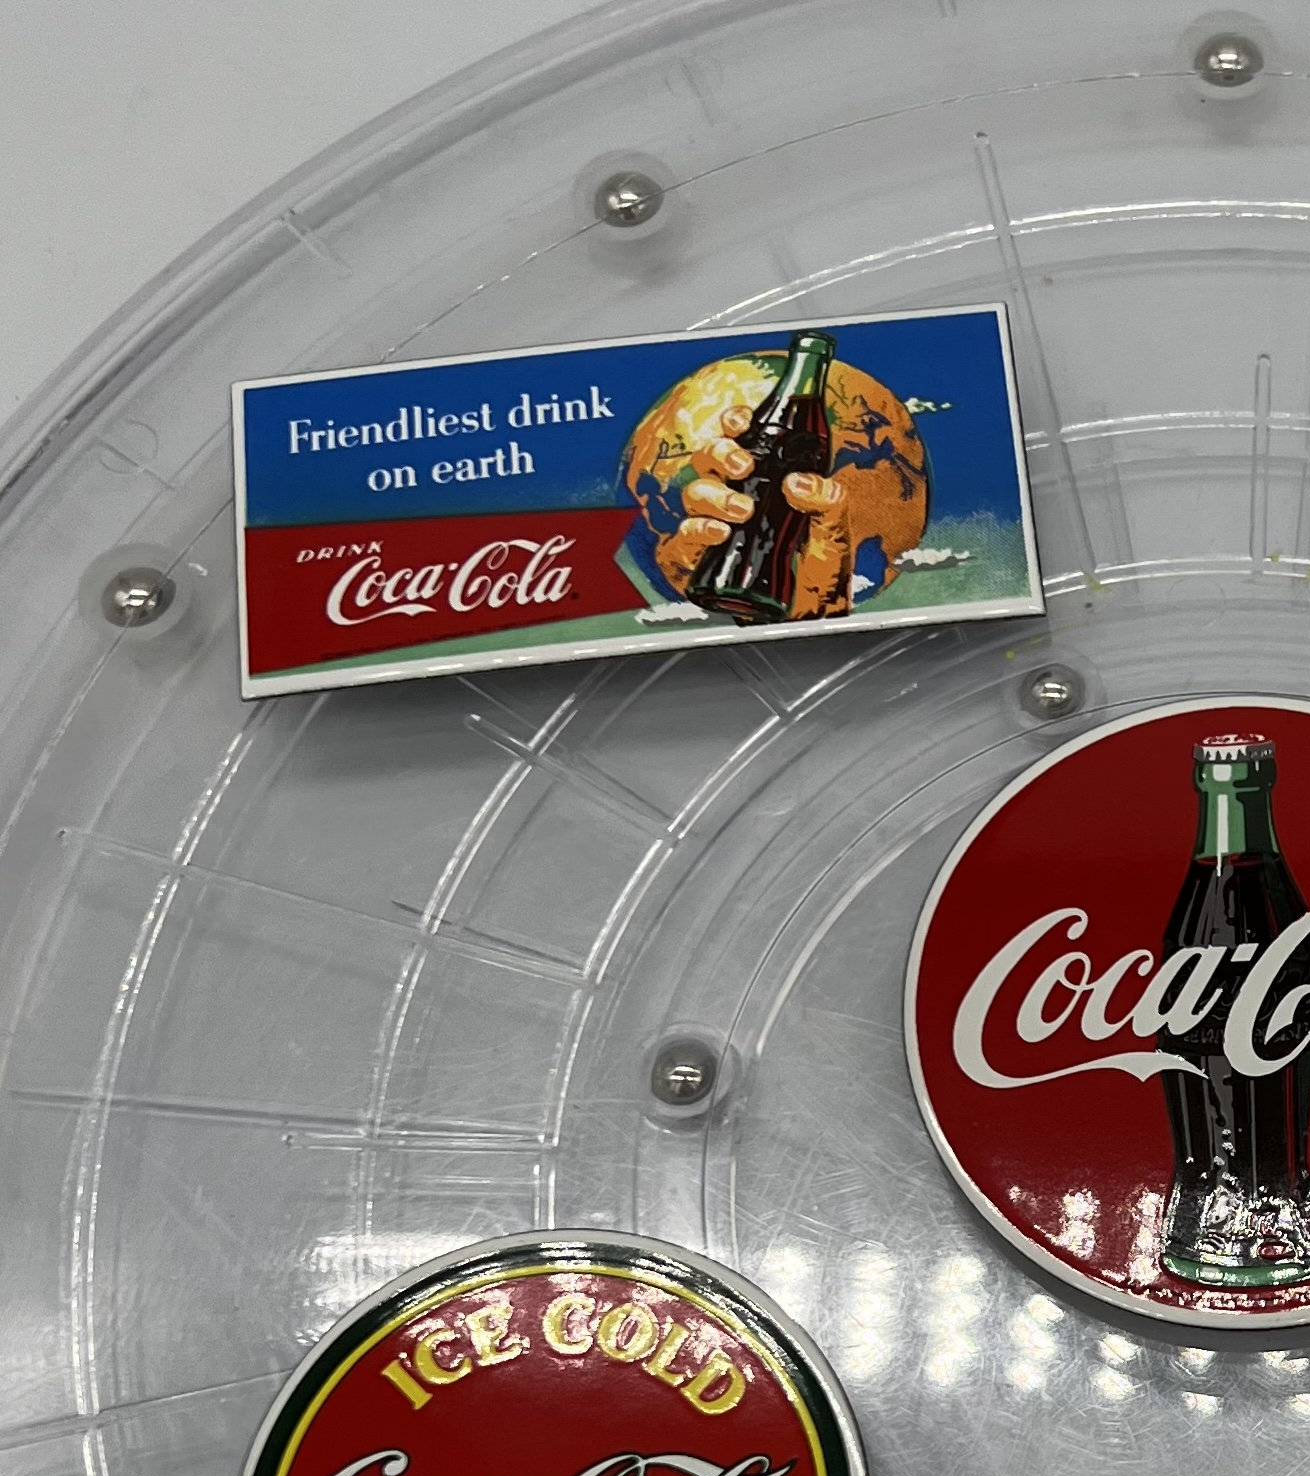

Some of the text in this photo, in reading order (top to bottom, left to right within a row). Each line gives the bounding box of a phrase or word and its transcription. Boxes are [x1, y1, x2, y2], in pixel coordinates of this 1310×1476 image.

[288, 386, 615, 455] Friendliest drink
[367, 443, 536, 492] on earth
[294, 539, 385, 564] DRINK
[326, 534, 576, 626] Coca-Cola
[381, 1296, 748, 1416] ICE COLD
